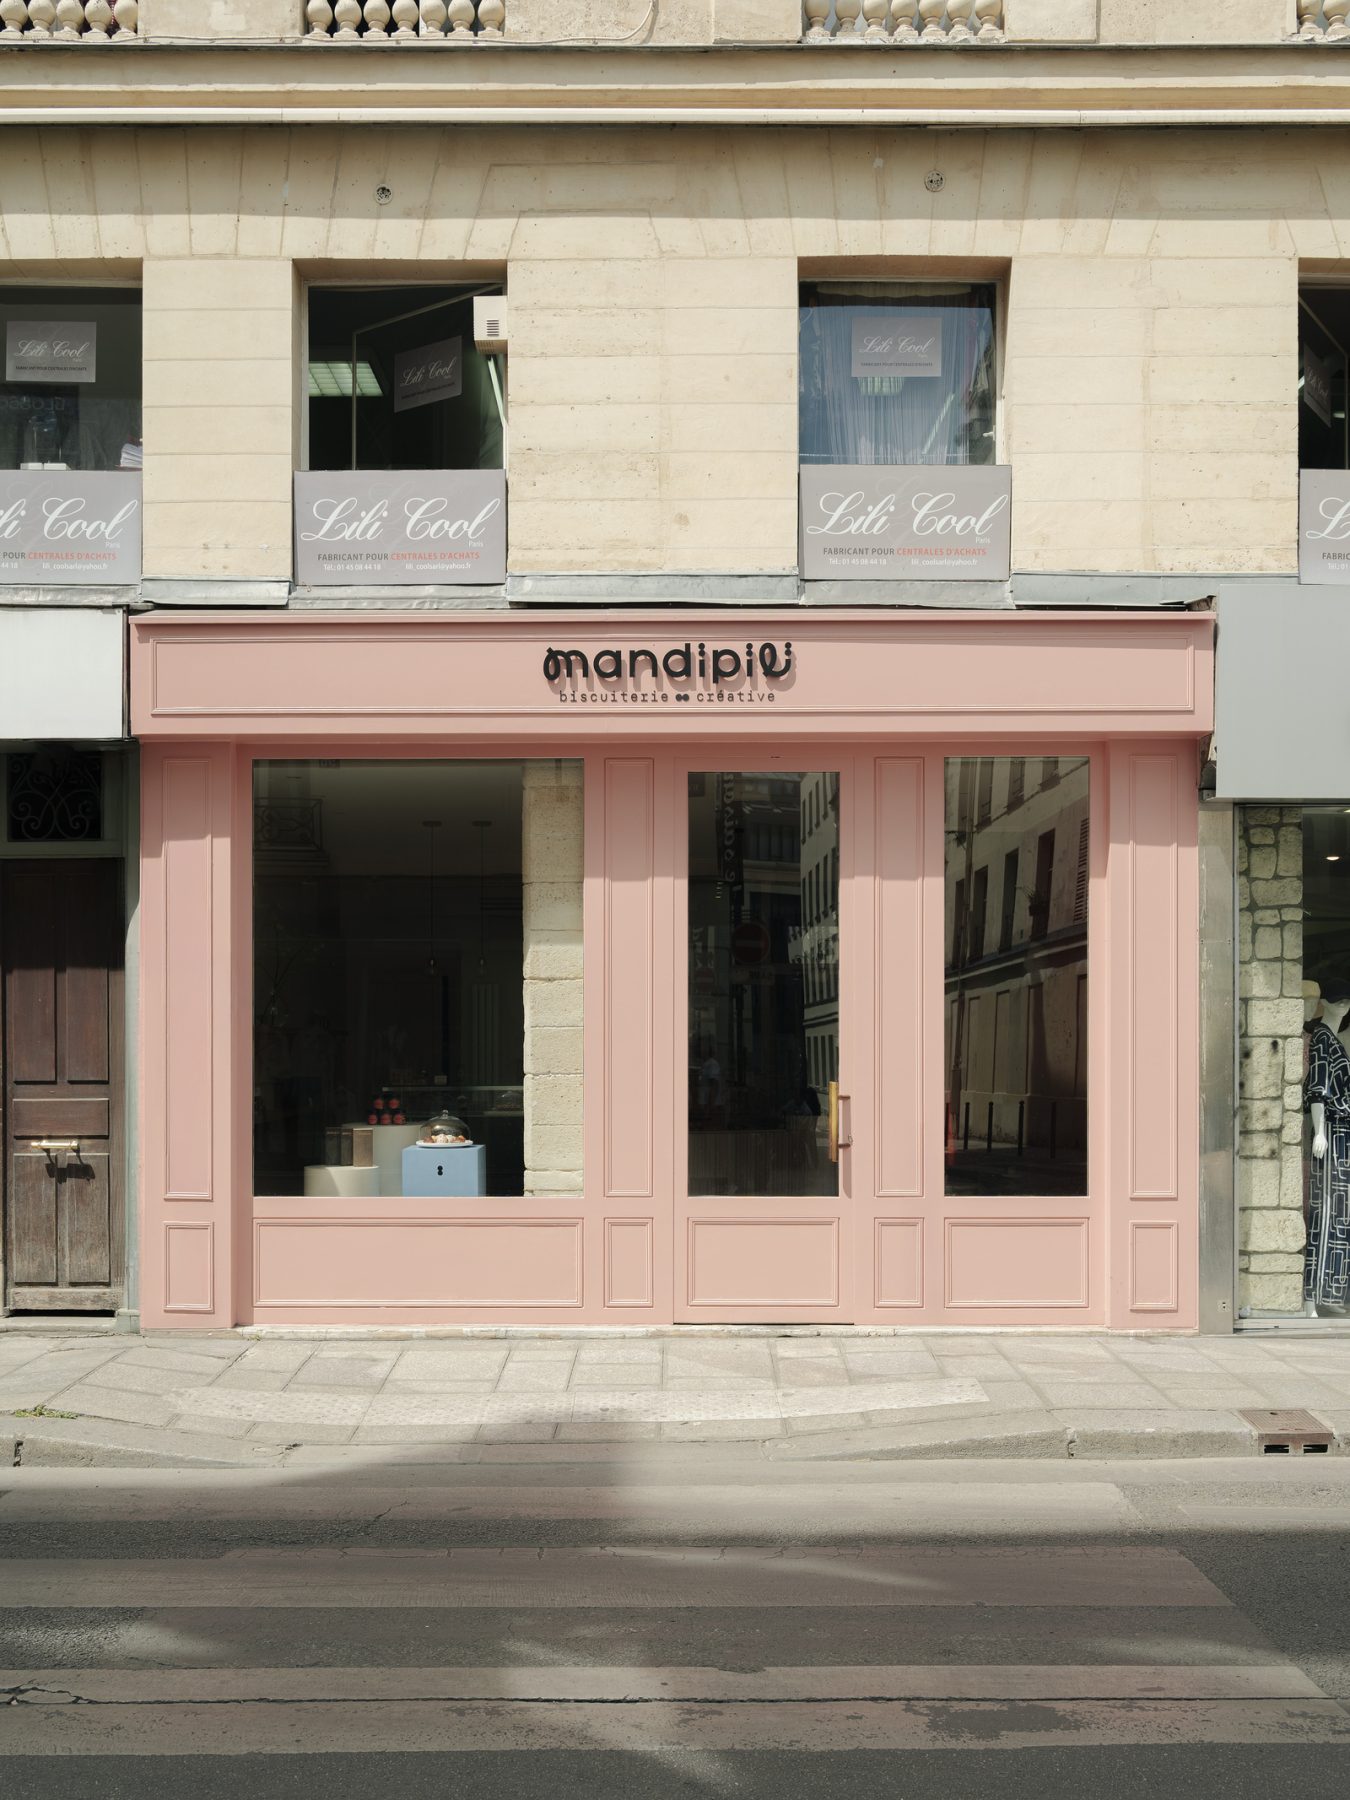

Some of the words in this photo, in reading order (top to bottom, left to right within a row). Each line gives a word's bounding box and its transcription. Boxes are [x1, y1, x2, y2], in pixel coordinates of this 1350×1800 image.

[52, 340, 90, 357] Cool
[898, 336, 936, 353] Cool
[428, 356, 457, 380] Cool
[42, 497, 138, 540] Cool
[300, 497, 389, 541] Lili
[404, 497, 501, 541] Cool
[806, 491, 896, 535] Lili
[911, 492, 1009, 536] Cool
[468, 540, 484, 548] Paris
[823, 547, 869, 555] FABRICANT
[871, 547, 895, 555] POUR
[897, 547, 944, 556] CENTRALES
[946, 547, 987, 556] D'ACHATS
[2, 551, 26, 559] POUR
[28, 551, 75, 560] CENTRALES
[77, 552, 118, 561] D'ACHATS
[317, 553, 364, 561] FABRICANT
[366, 553, 389, 561] POUR
[391, 552, 438, 560] CENTRALES
[439, 551, 480, 559] D'ACHATS
[543, 641, 792, 685] mandipili
[559, 690, 669, 703] biscuiterie
[696, 689, 776, 703] créative
